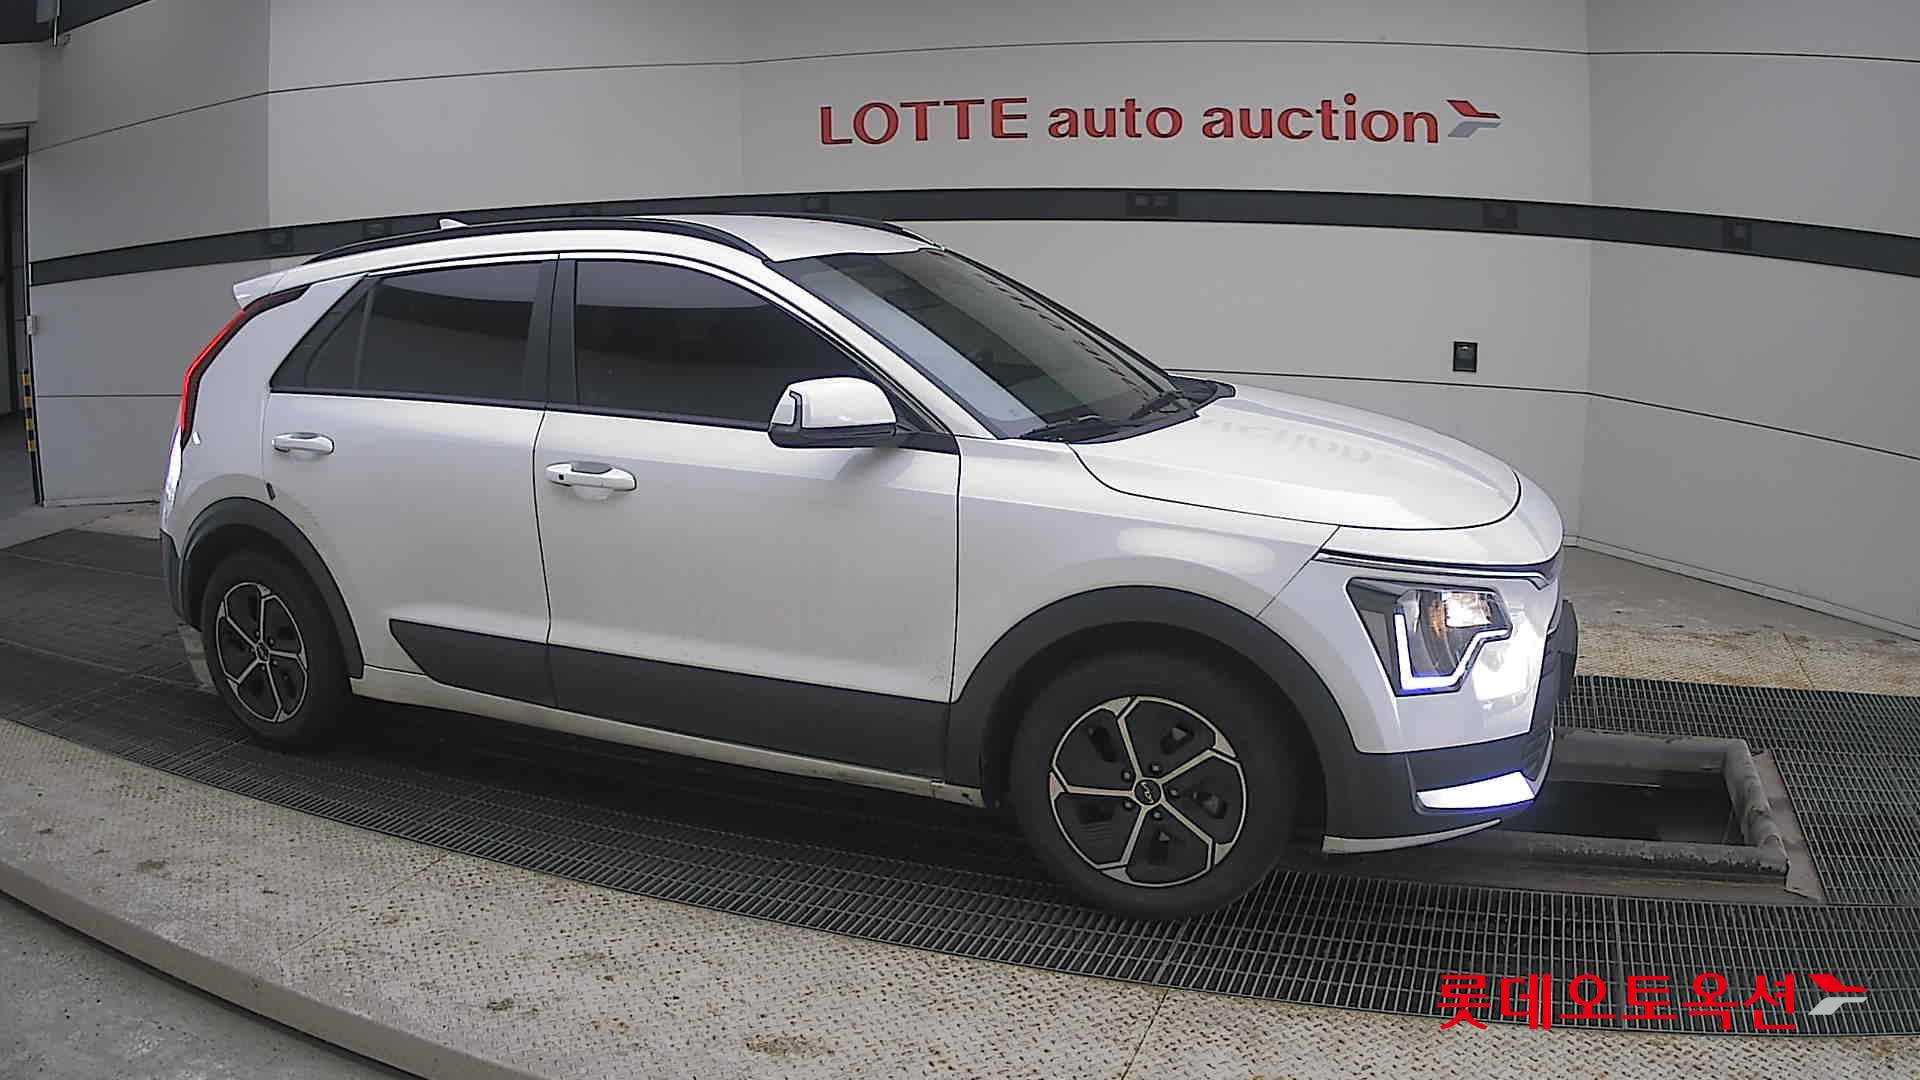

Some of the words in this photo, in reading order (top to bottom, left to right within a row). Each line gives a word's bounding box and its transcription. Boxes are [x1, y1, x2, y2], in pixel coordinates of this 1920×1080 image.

[820, 98, 1028, 146] LOTTE
[1047, 98, 1184, 138] auto
[1202, 94, 1439, 143] auction
